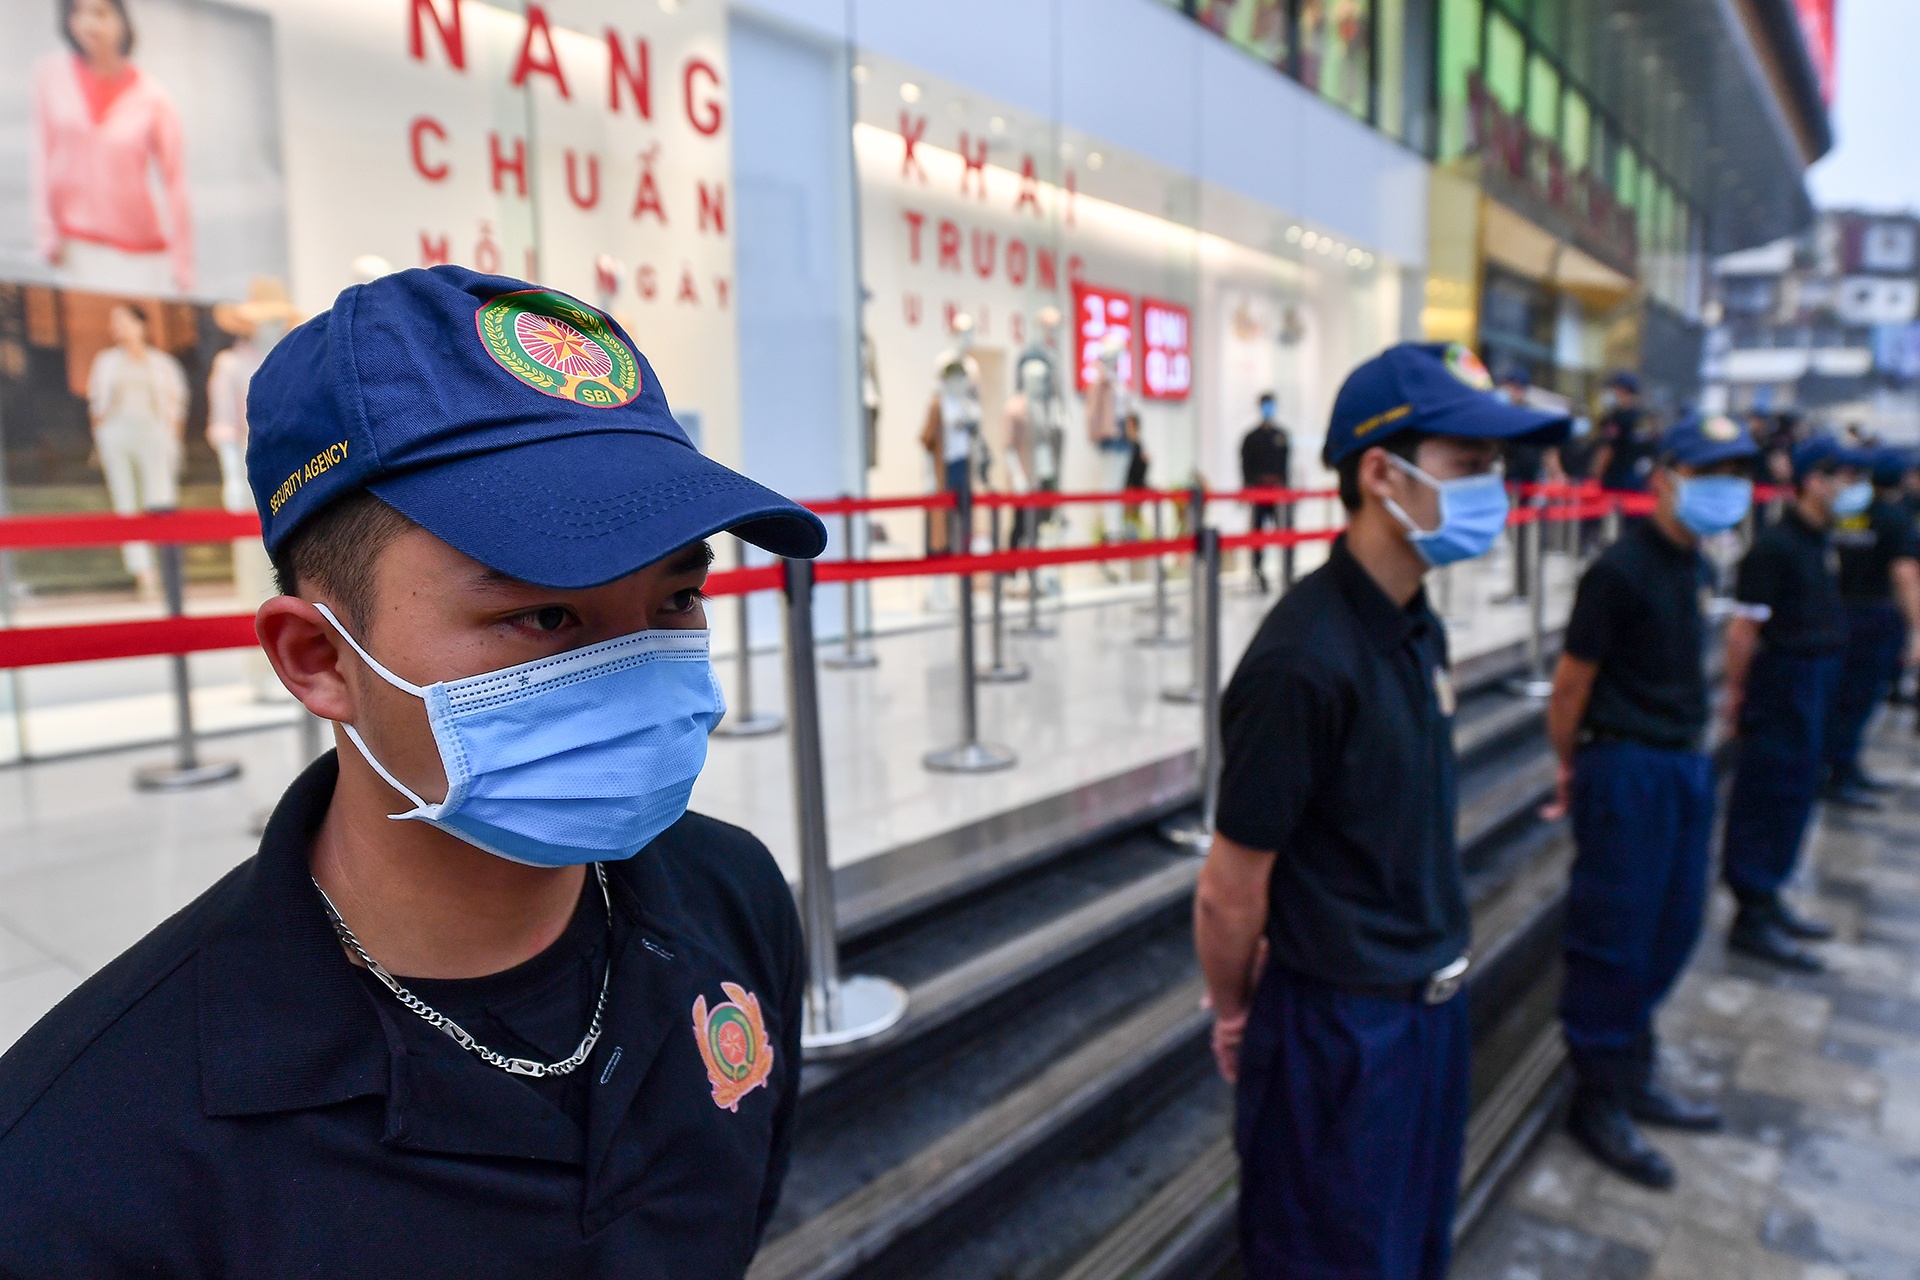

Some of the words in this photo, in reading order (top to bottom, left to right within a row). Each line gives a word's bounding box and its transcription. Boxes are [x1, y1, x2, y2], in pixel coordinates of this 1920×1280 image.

[899, 110, 1076, 228] KHAI
[582, 388, 612, 403] SBI
[270, 469, 303, 516] SECURITY
[305, 440, 349, 484] AGENCY
